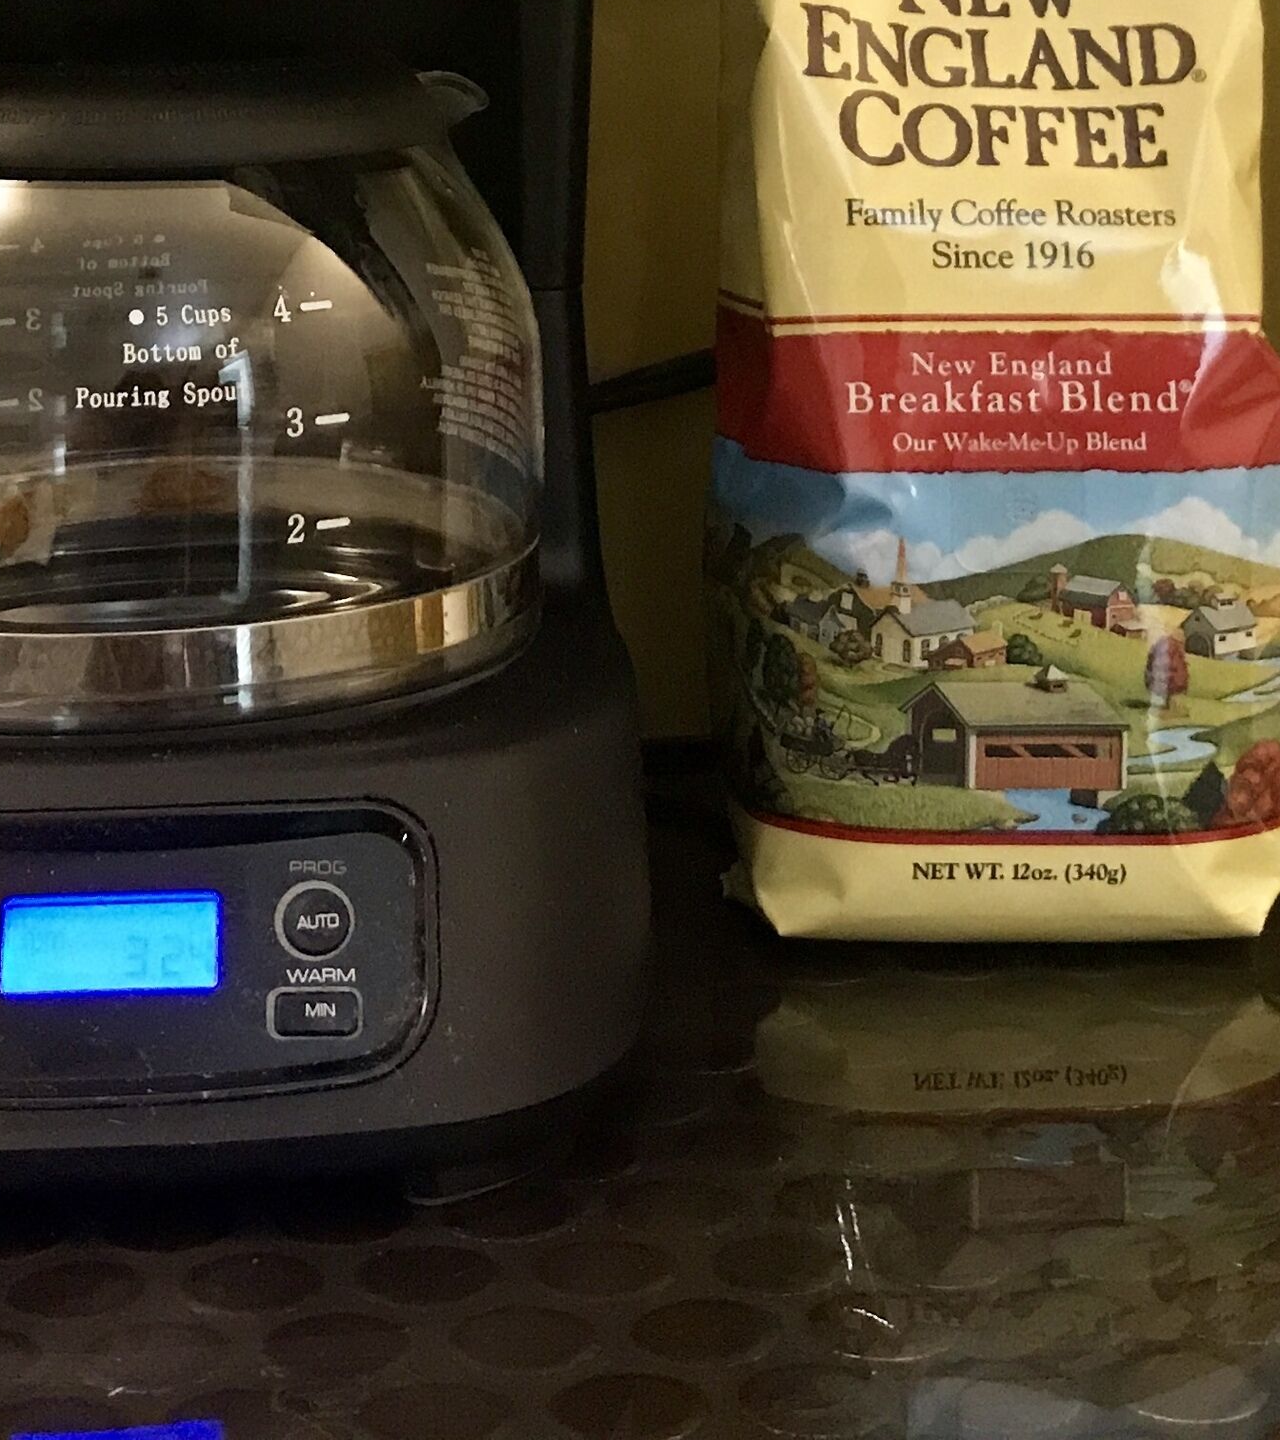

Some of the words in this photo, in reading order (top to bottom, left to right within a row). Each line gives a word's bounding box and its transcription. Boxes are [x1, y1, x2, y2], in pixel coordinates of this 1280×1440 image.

[839, 88, 1168, 168] COFFEE
[845, 198, 943, 232] Family
[951, 198, 1046, 227] Coffee
[1055, 199, 1176, 227] Roasters
[931, 240, 1014, 269] Since
[1025, 240, 1095, 269] 1916
[157, 305, 168, 326] 5
[181, 304, 231, 327] Cups
[273, 294, 292, 322] 4
[122, 343, 202, 364] Bottom
[215, 337, 240, 358] of
[910, 351, 975, 376] New
[989, 350, 1113, 380] England
[75, 385, 170, 409] Pouring
[183, 381, 238, 407] Spou
[845, 379, 1042, 414] Breakfast
[286, 407, 304, 438] 3
[892, 432, 936, 452] Our
[942, 431, 1079, 455] Wake-Me-Up
[1086, 431, 1147, 452] Blend
[286, 513, 305, 544] 2
[289, 860, 348, 876] PROG
[912, 862, 960, 880] NET
[964, 862, 1004, 880] WT.
[1011, 863, 1058, 881] 12oz.
[1064, 863, 1128, 885] (340g)
[296, 912, 340, 931] AUTO
[286, 967, 356, 984] WARM
[304, 1002, 336, 1018] MIN
